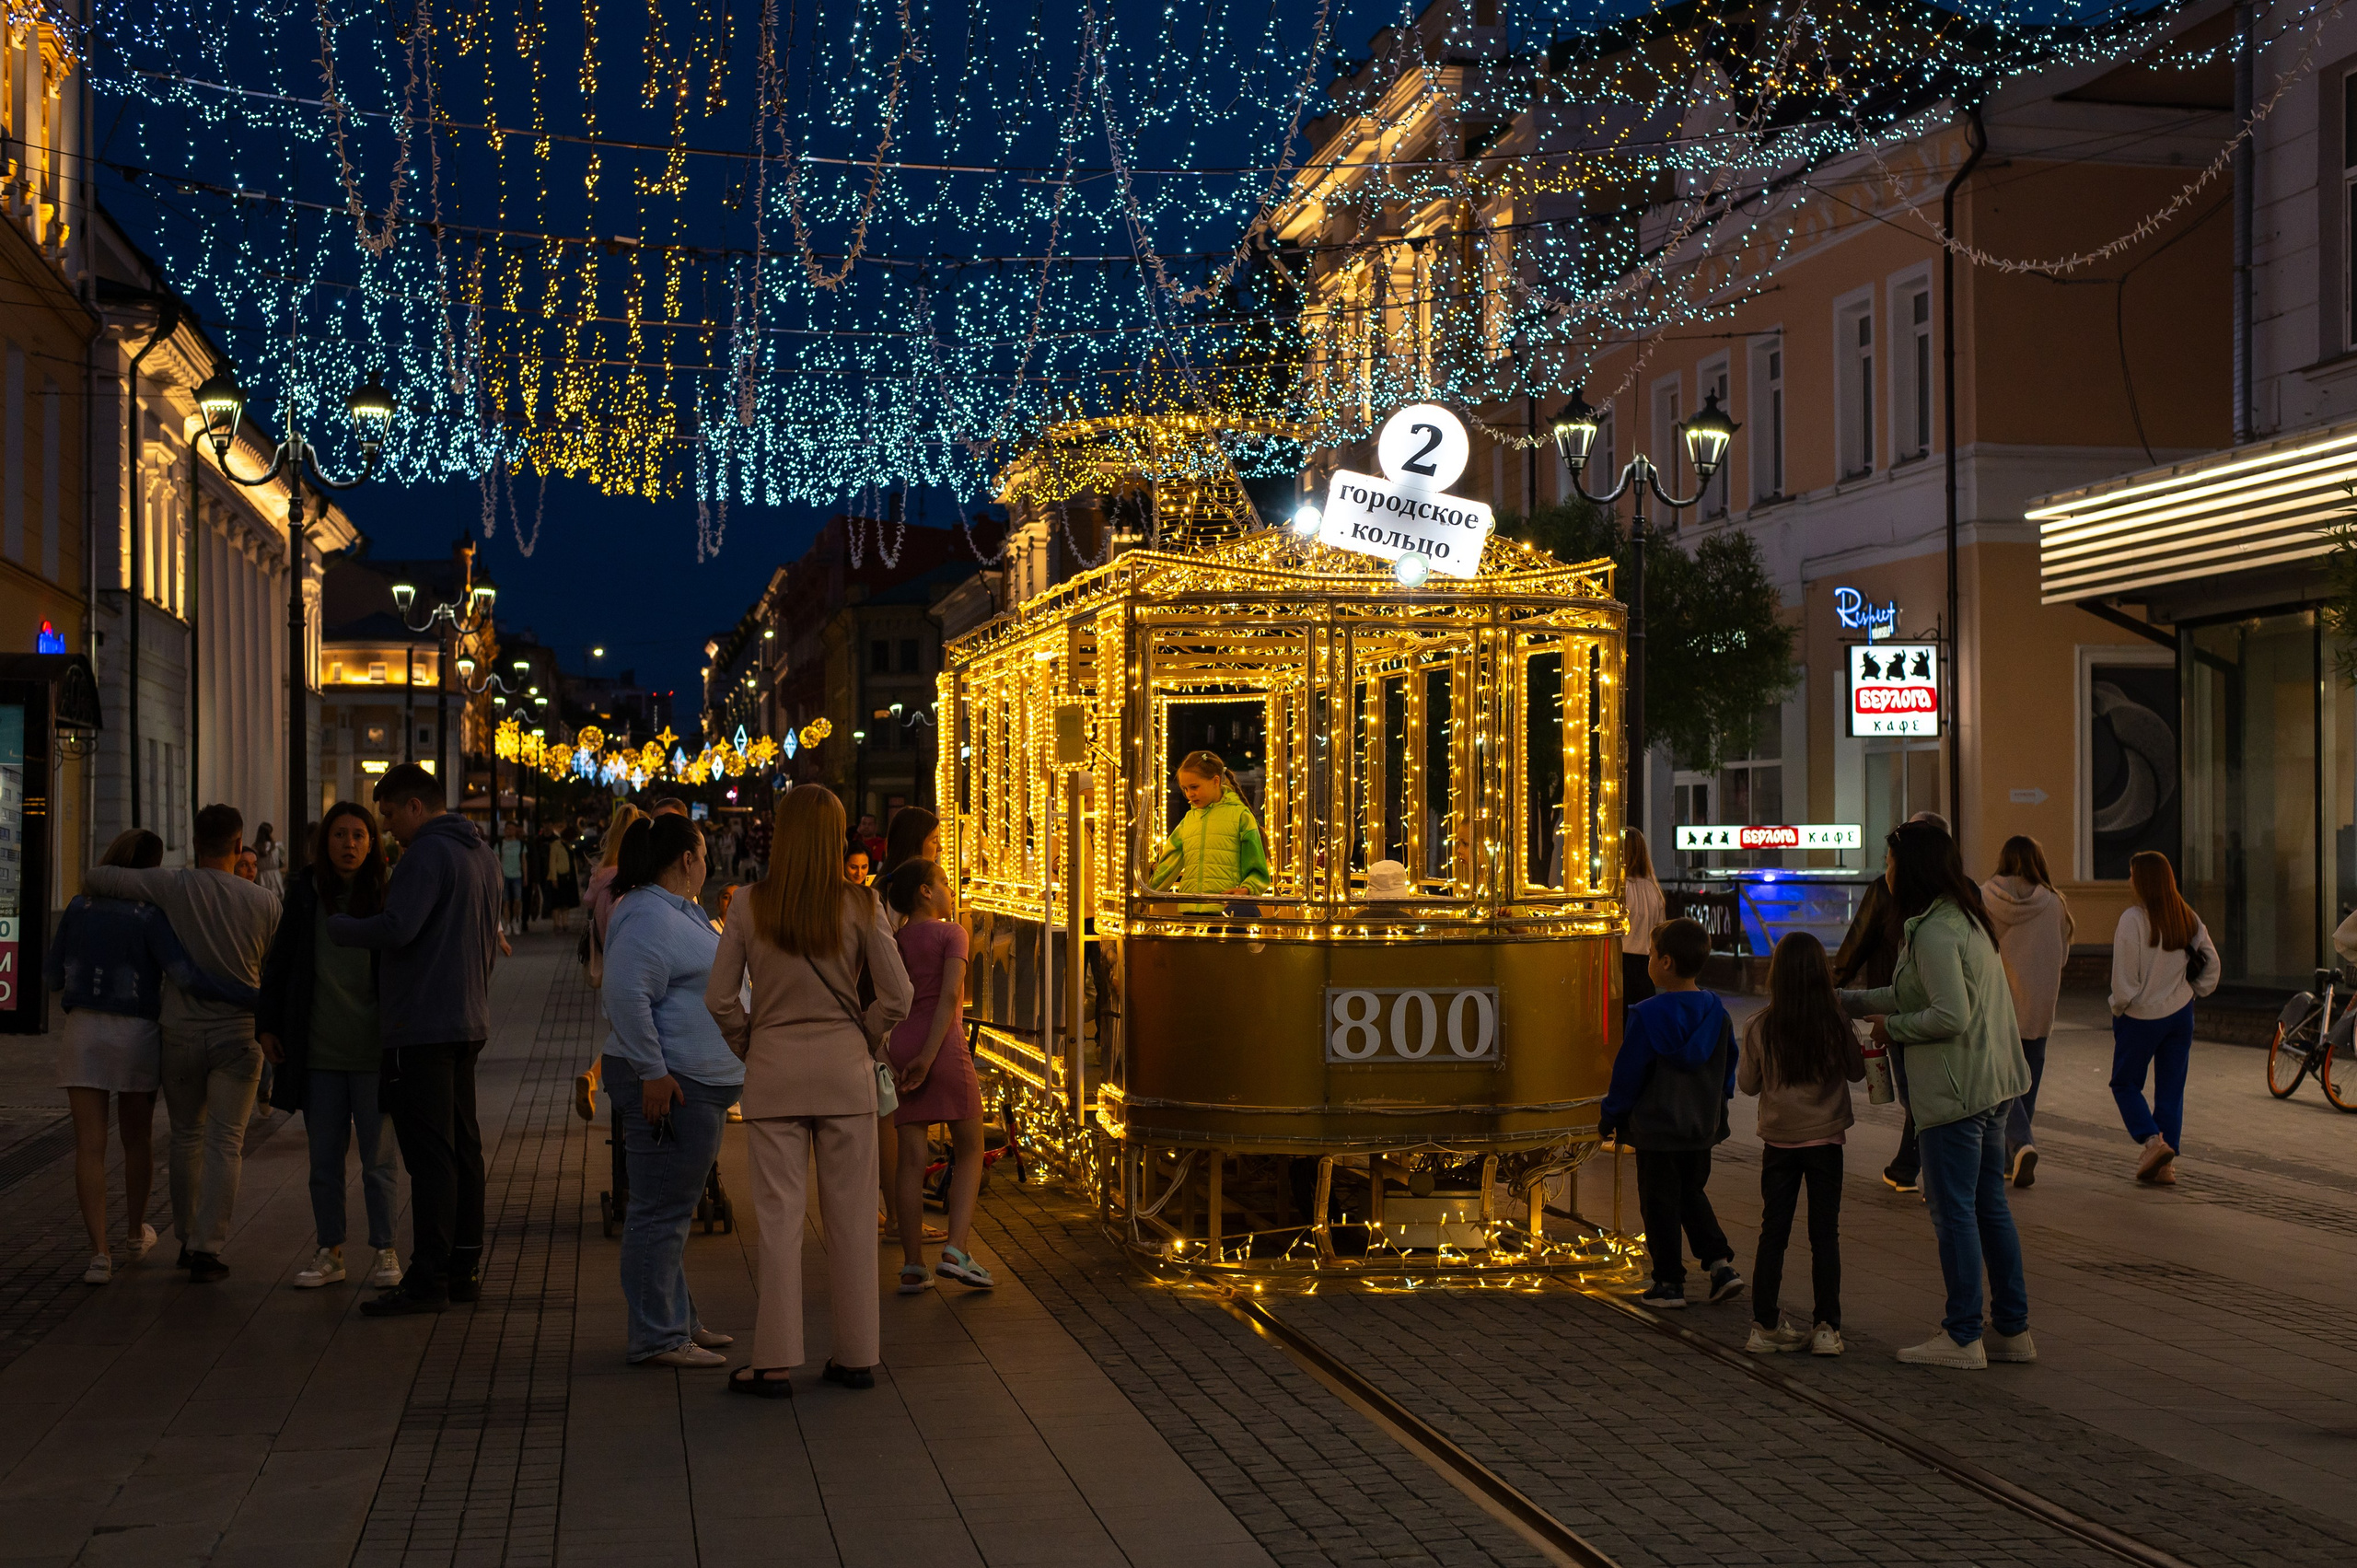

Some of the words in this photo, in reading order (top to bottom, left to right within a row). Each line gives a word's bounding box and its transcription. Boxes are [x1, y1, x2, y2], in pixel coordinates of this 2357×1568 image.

[1400, 424, 1444, 477] 2
[1339, 484, 1479, 529] городское
[1351, 522, 1450, 560] кольцо
[1331, 990, 1494, 1059] 800
